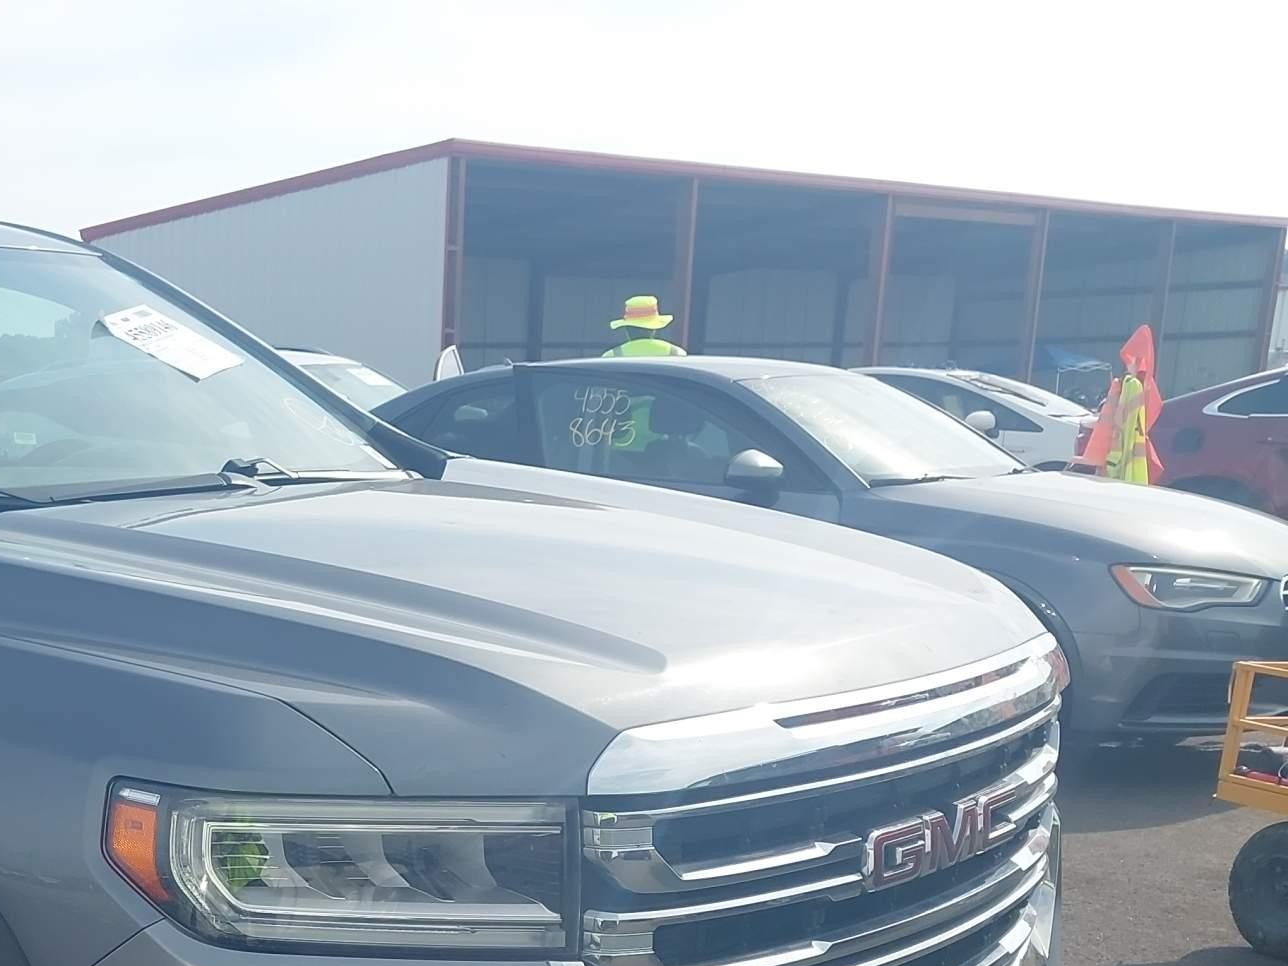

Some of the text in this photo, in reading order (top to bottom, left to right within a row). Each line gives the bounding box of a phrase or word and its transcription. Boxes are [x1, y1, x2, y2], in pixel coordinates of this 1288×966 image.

[574, 386, 631, 415] 4555
[569, 417, 636, 448] 8643
[862, 782, 1017, 892] GMC
